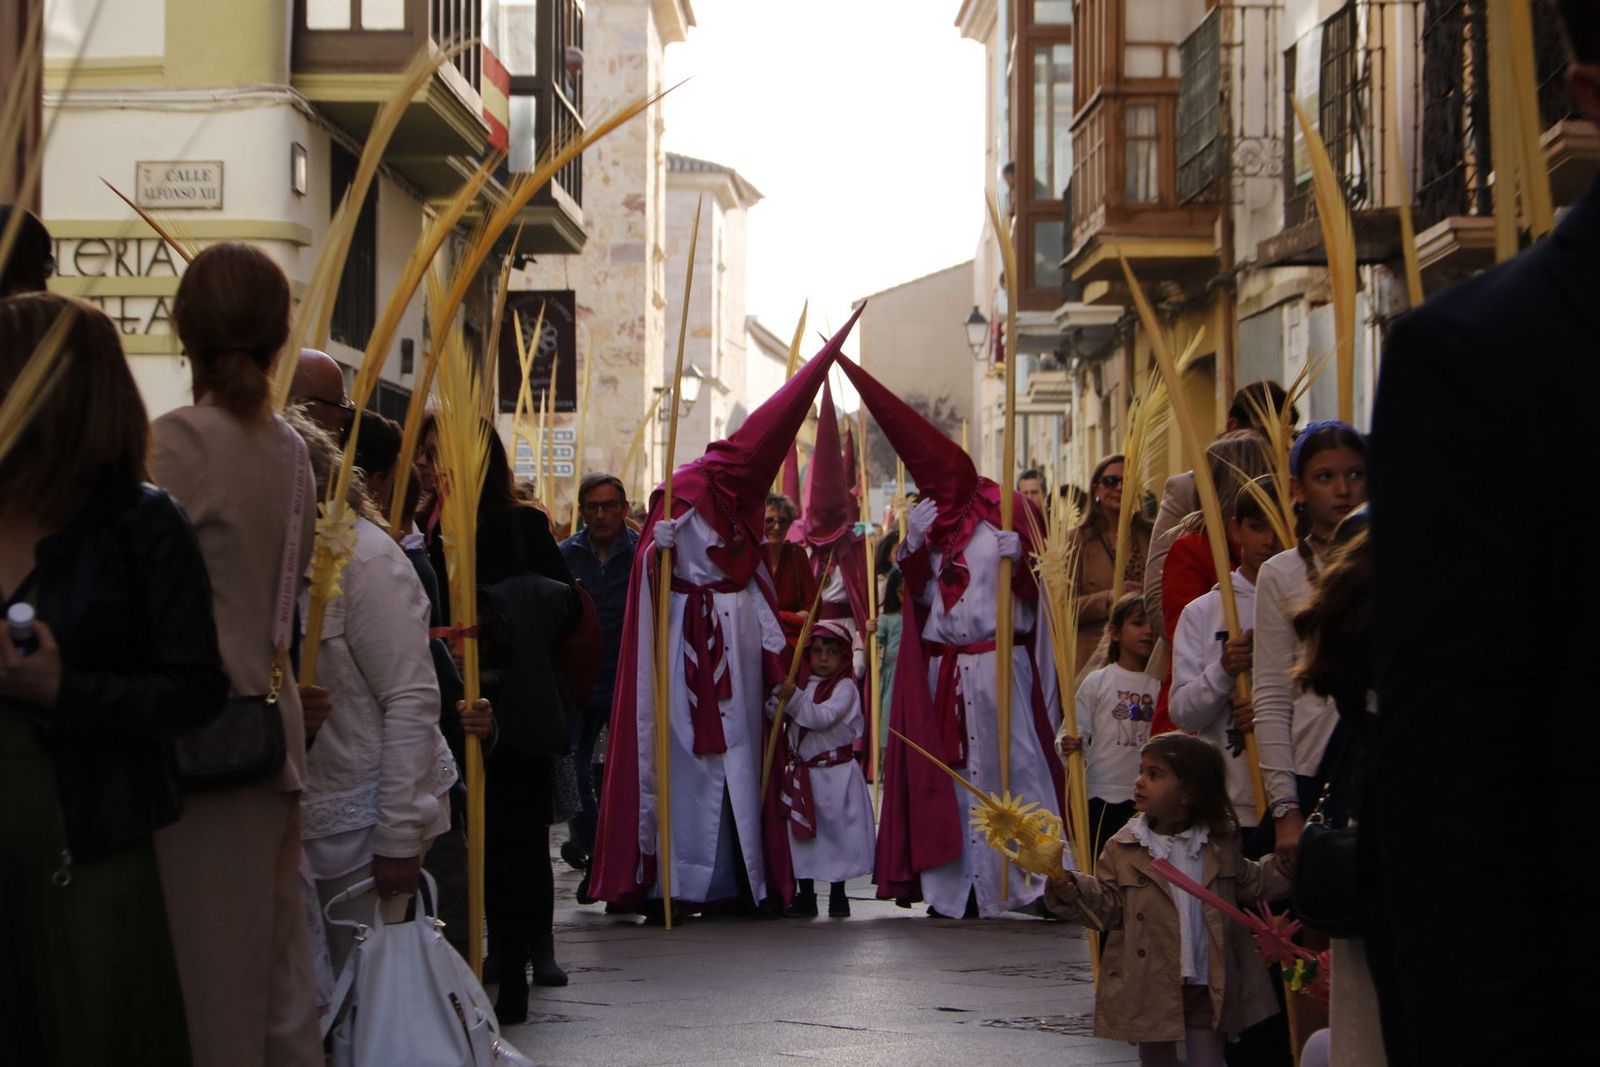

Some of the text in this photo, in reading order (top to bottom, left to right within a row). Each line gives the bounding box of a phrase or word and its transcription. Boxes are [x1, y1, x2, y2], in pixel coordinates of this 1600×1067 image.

[165, 168, 212, 182] CALLE
[143, 187, 216, 200] ALFONSO XII
